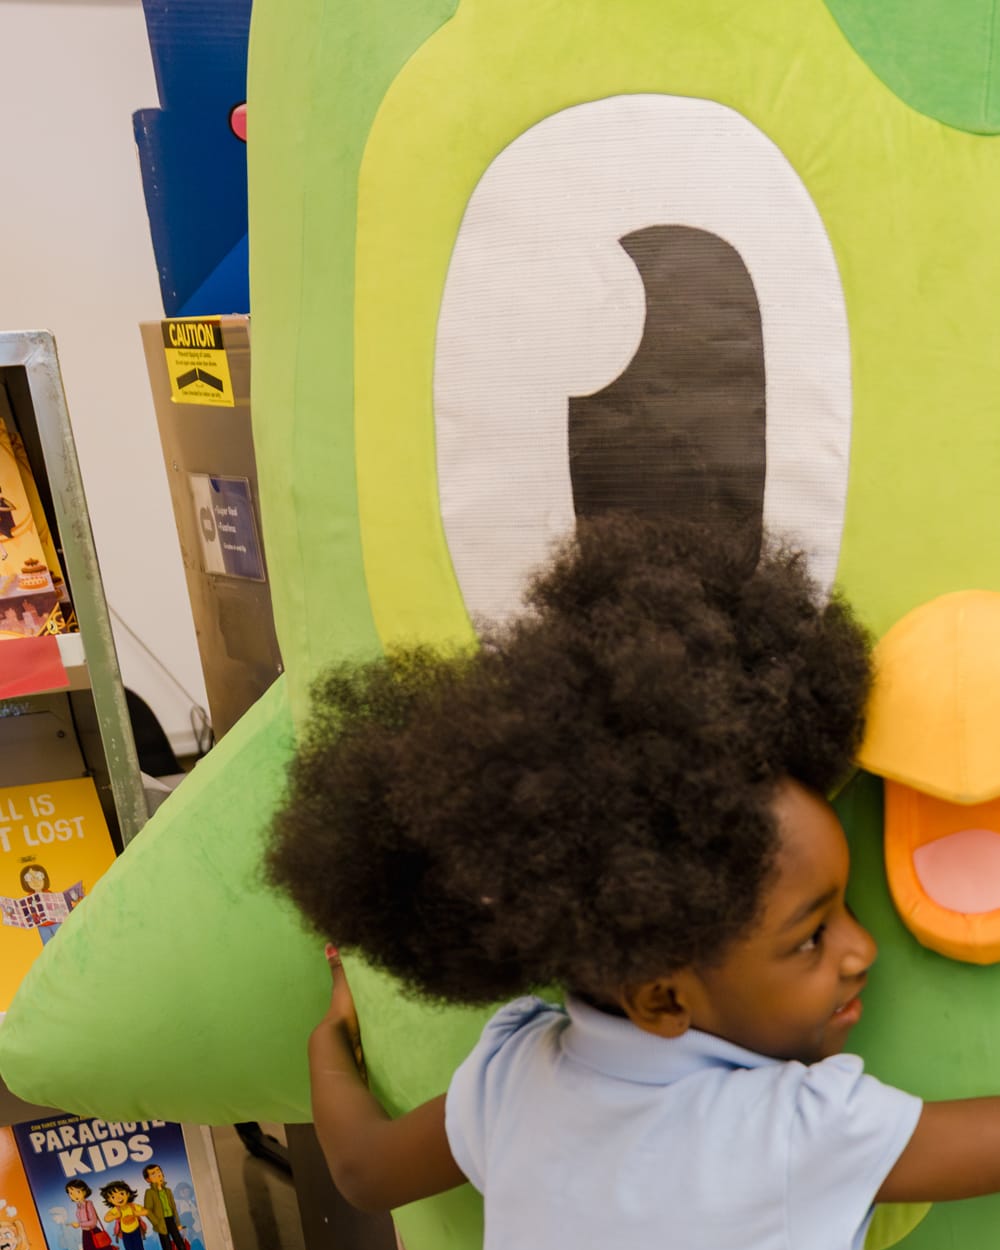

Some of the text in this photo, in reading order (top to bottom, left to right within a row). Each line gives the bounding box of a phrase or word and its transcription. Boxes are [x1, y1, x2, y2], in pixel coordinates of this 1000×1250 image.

[168, 323, 216, 348] CAUTION
[29, 794, 56, 818] IS
[22, 816, 85, 847] LOST
[58, 1134, 154, 1178] KIDS
